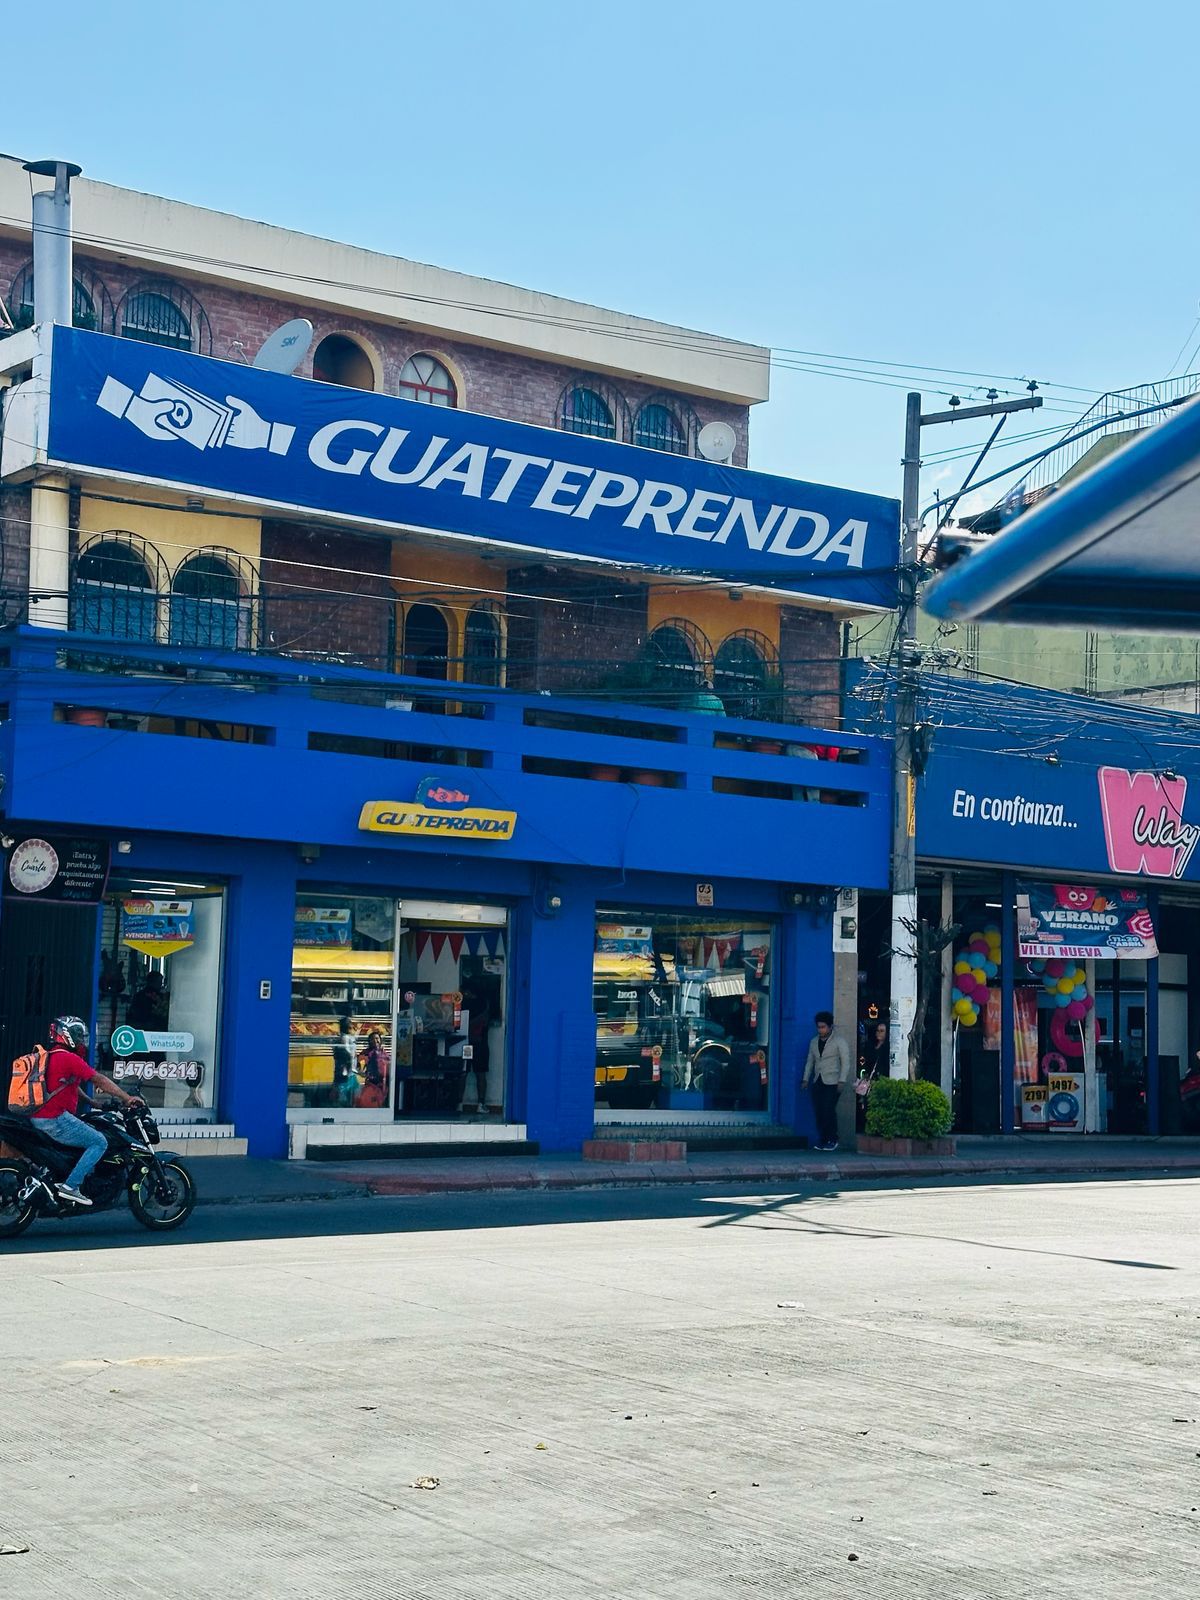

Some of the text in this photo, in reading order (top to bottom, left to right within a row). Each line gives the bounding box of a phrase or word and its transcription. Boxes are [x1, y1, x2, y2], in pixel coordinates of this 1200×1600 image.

[281, 335, 299, 347] SKY
[307, 419, 869, 568] GUATEPRENDA
[952, 789, 976, 819] En
[980, 795, 1078, 828] confianza...
[1134, 805, 1200, 878] Way
[1040, 910, 1119, 926] VERANO
[1050, 922, 1111, 931] REFRESCANTE
[1021, 944, 1103, 957] VILLA NUEVA
[150, 1040, 185, 1049] WhatsApp
[114, 1062, 198, 1079] 5476-6214
[1051, 1080, 1073, 1091] 1497
[1024, 1090, 1047, 1101] 2797
